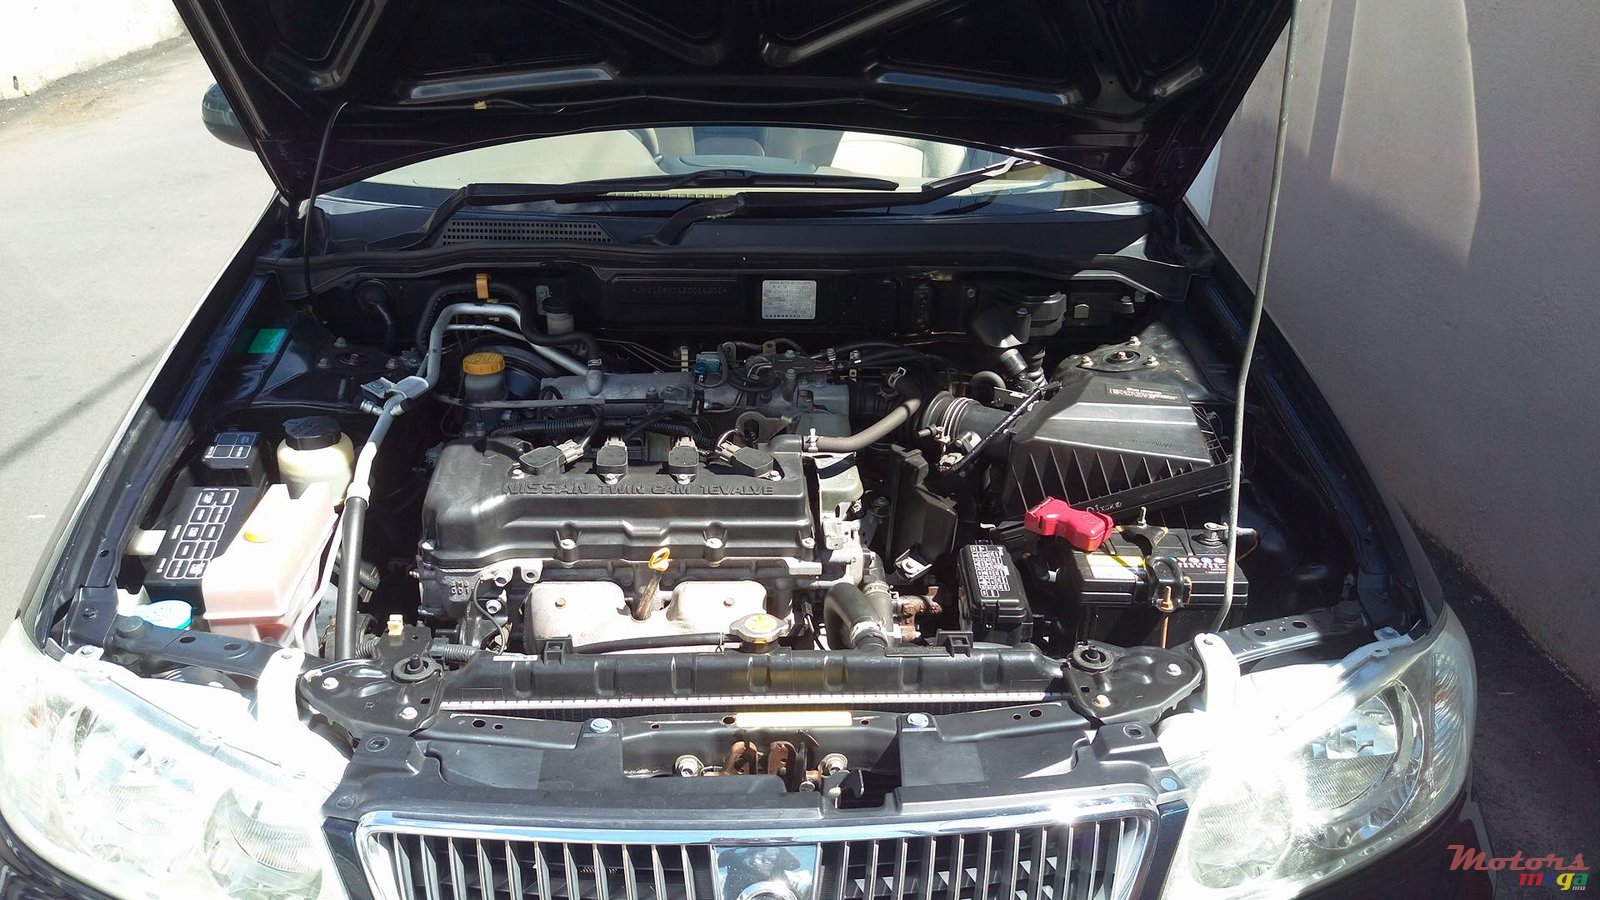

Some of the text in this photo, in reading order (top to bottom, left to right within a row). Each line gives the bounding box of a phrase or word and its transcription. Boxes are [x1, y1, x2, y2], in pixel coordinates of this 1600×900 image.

[502, 482, 590, 495] NISSAN
[598, 483, 645, 495] TWIN
[651, 484, 691, 495] CAM
